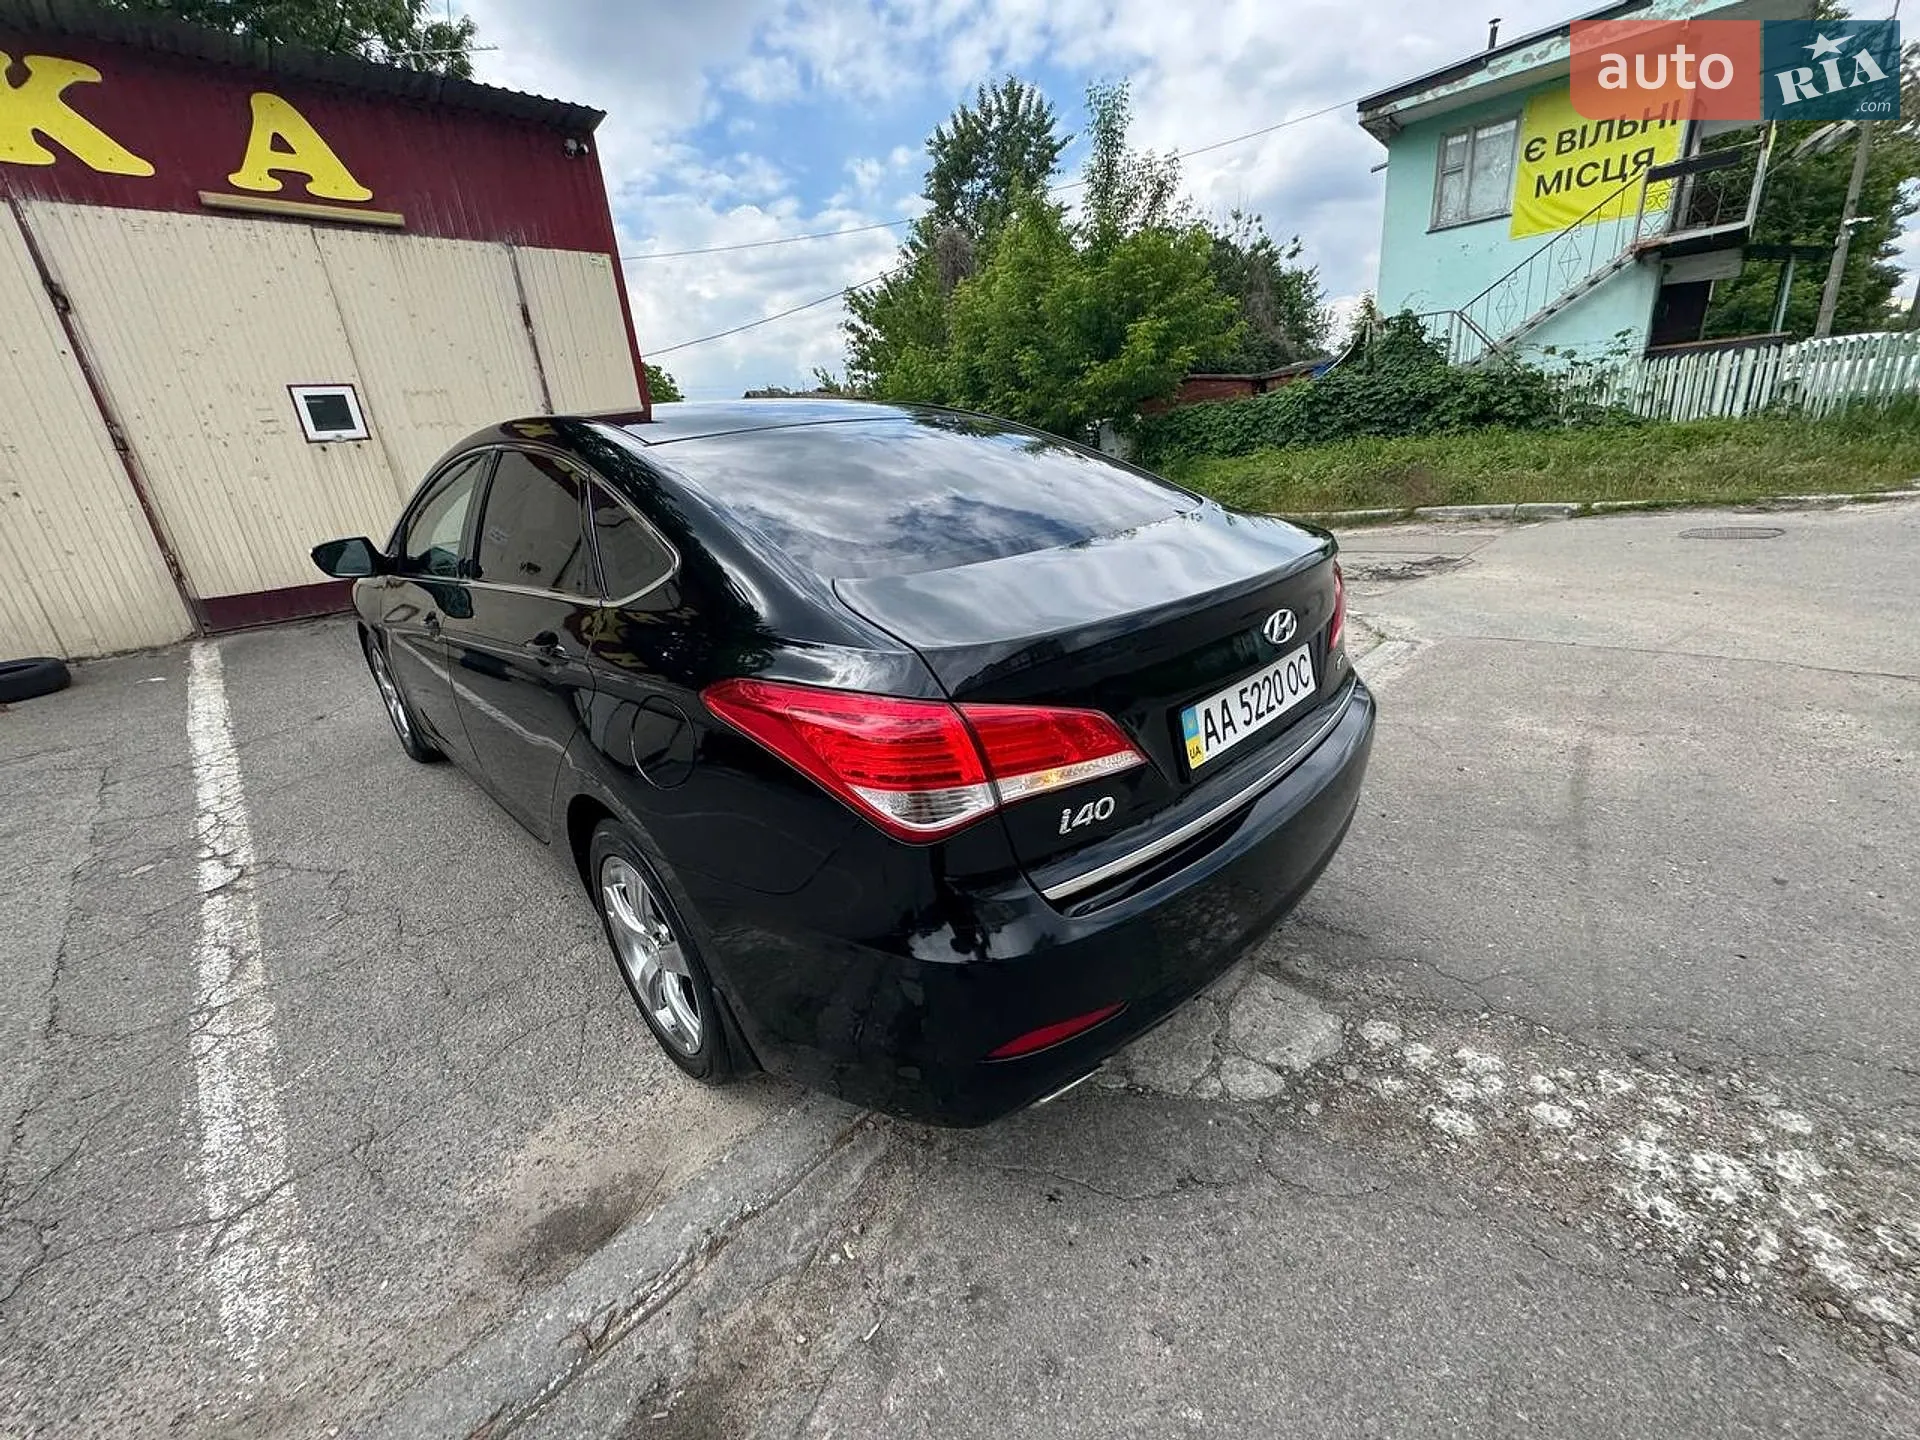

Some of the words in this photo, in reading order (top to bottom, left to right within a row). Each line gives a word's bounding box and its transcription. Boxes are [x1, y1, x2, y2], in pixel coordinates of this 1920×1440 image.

[1524, 134, 1546, 163] Є
[1556, 99, 1681, 157] ВІЛЬНІ
[1535, 147, 1655, 198] МІСЦЯ
[1203, 698, 1237, 752] AA
[1238, 669, 1284, 726] 5220
[1286, 654, 1310, 696] OC
[1189, 745, 1202, 760] UA
[1059, 796, 1116, 835] i40
